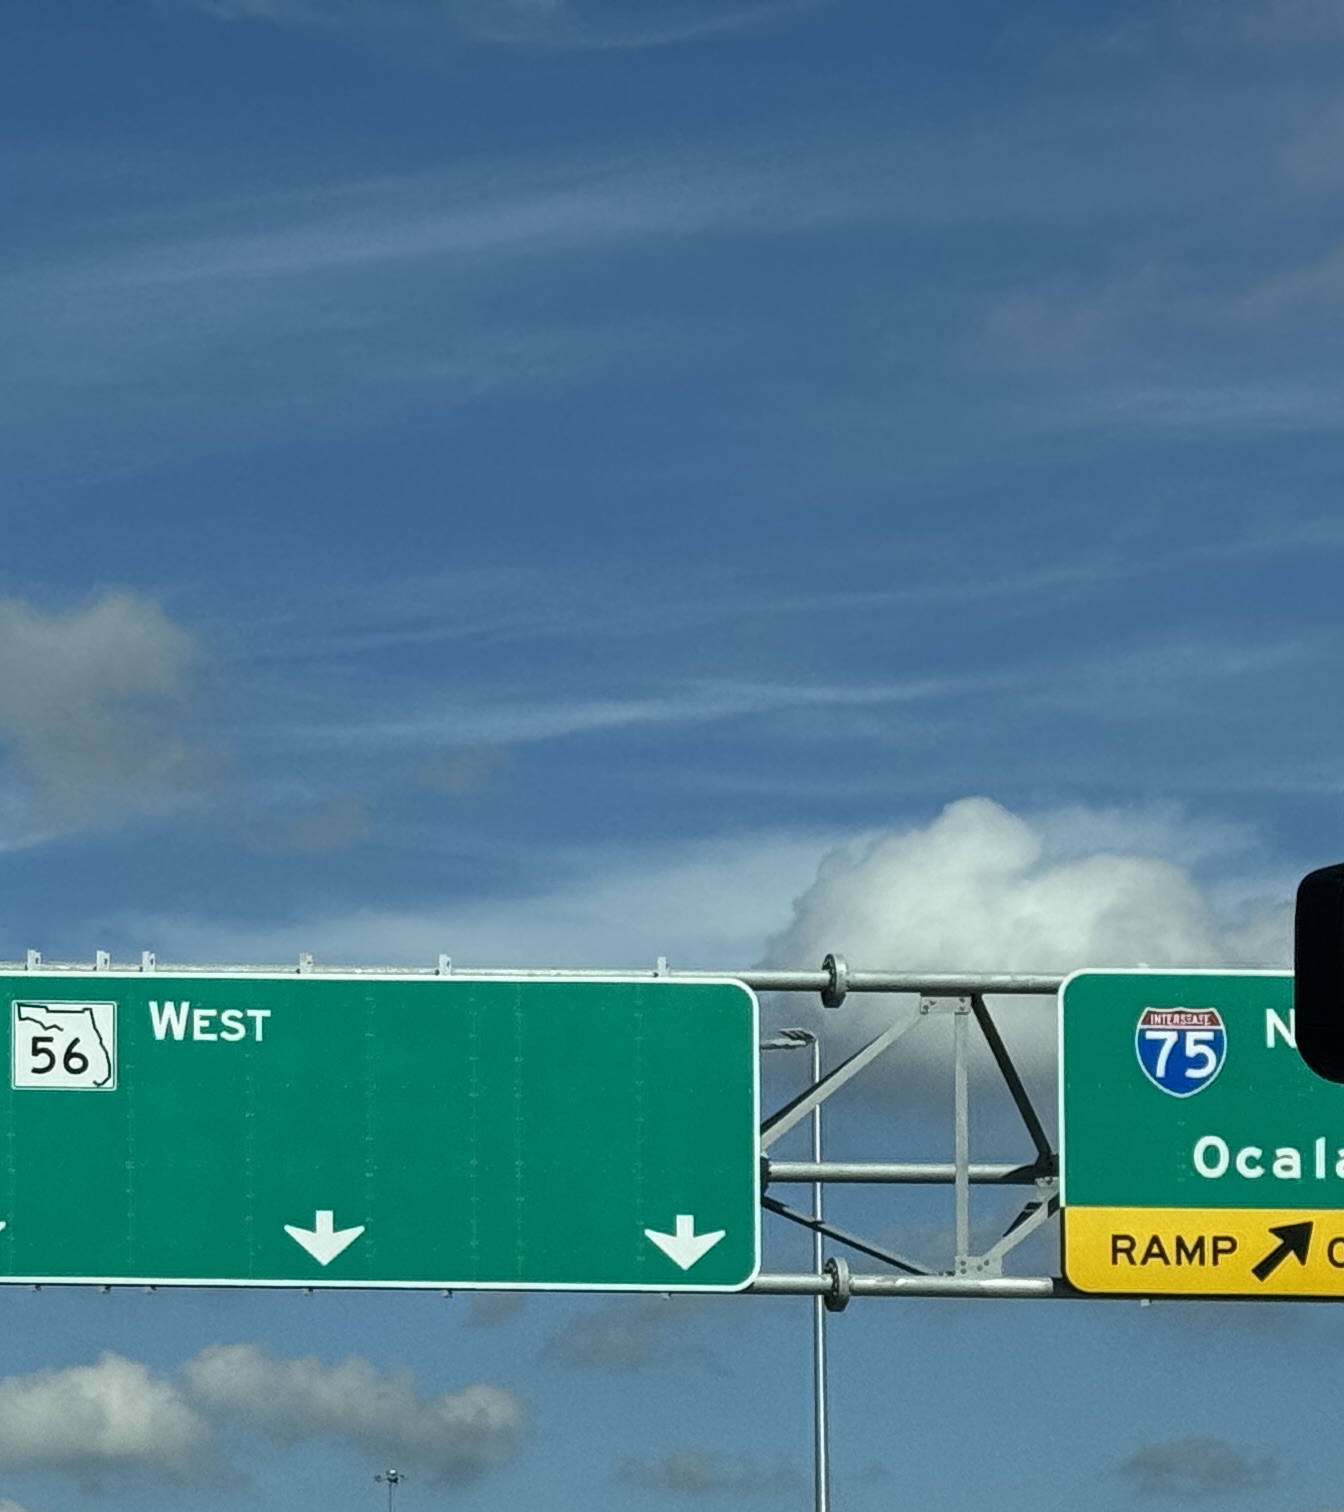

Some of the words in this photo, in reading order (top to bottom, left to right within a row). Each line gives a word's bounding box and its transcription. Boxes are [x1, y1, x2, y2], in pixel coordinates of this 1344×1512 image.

[148, 1000, 272, 1042] WEST
[1150, 1012, 1213, 1026] INTERSTATE
[31, 1036, 89, 1075] 56
[1144, 1031, 1217, 1078] 75
[1112, 1234, 1238, 1267] RAMP
